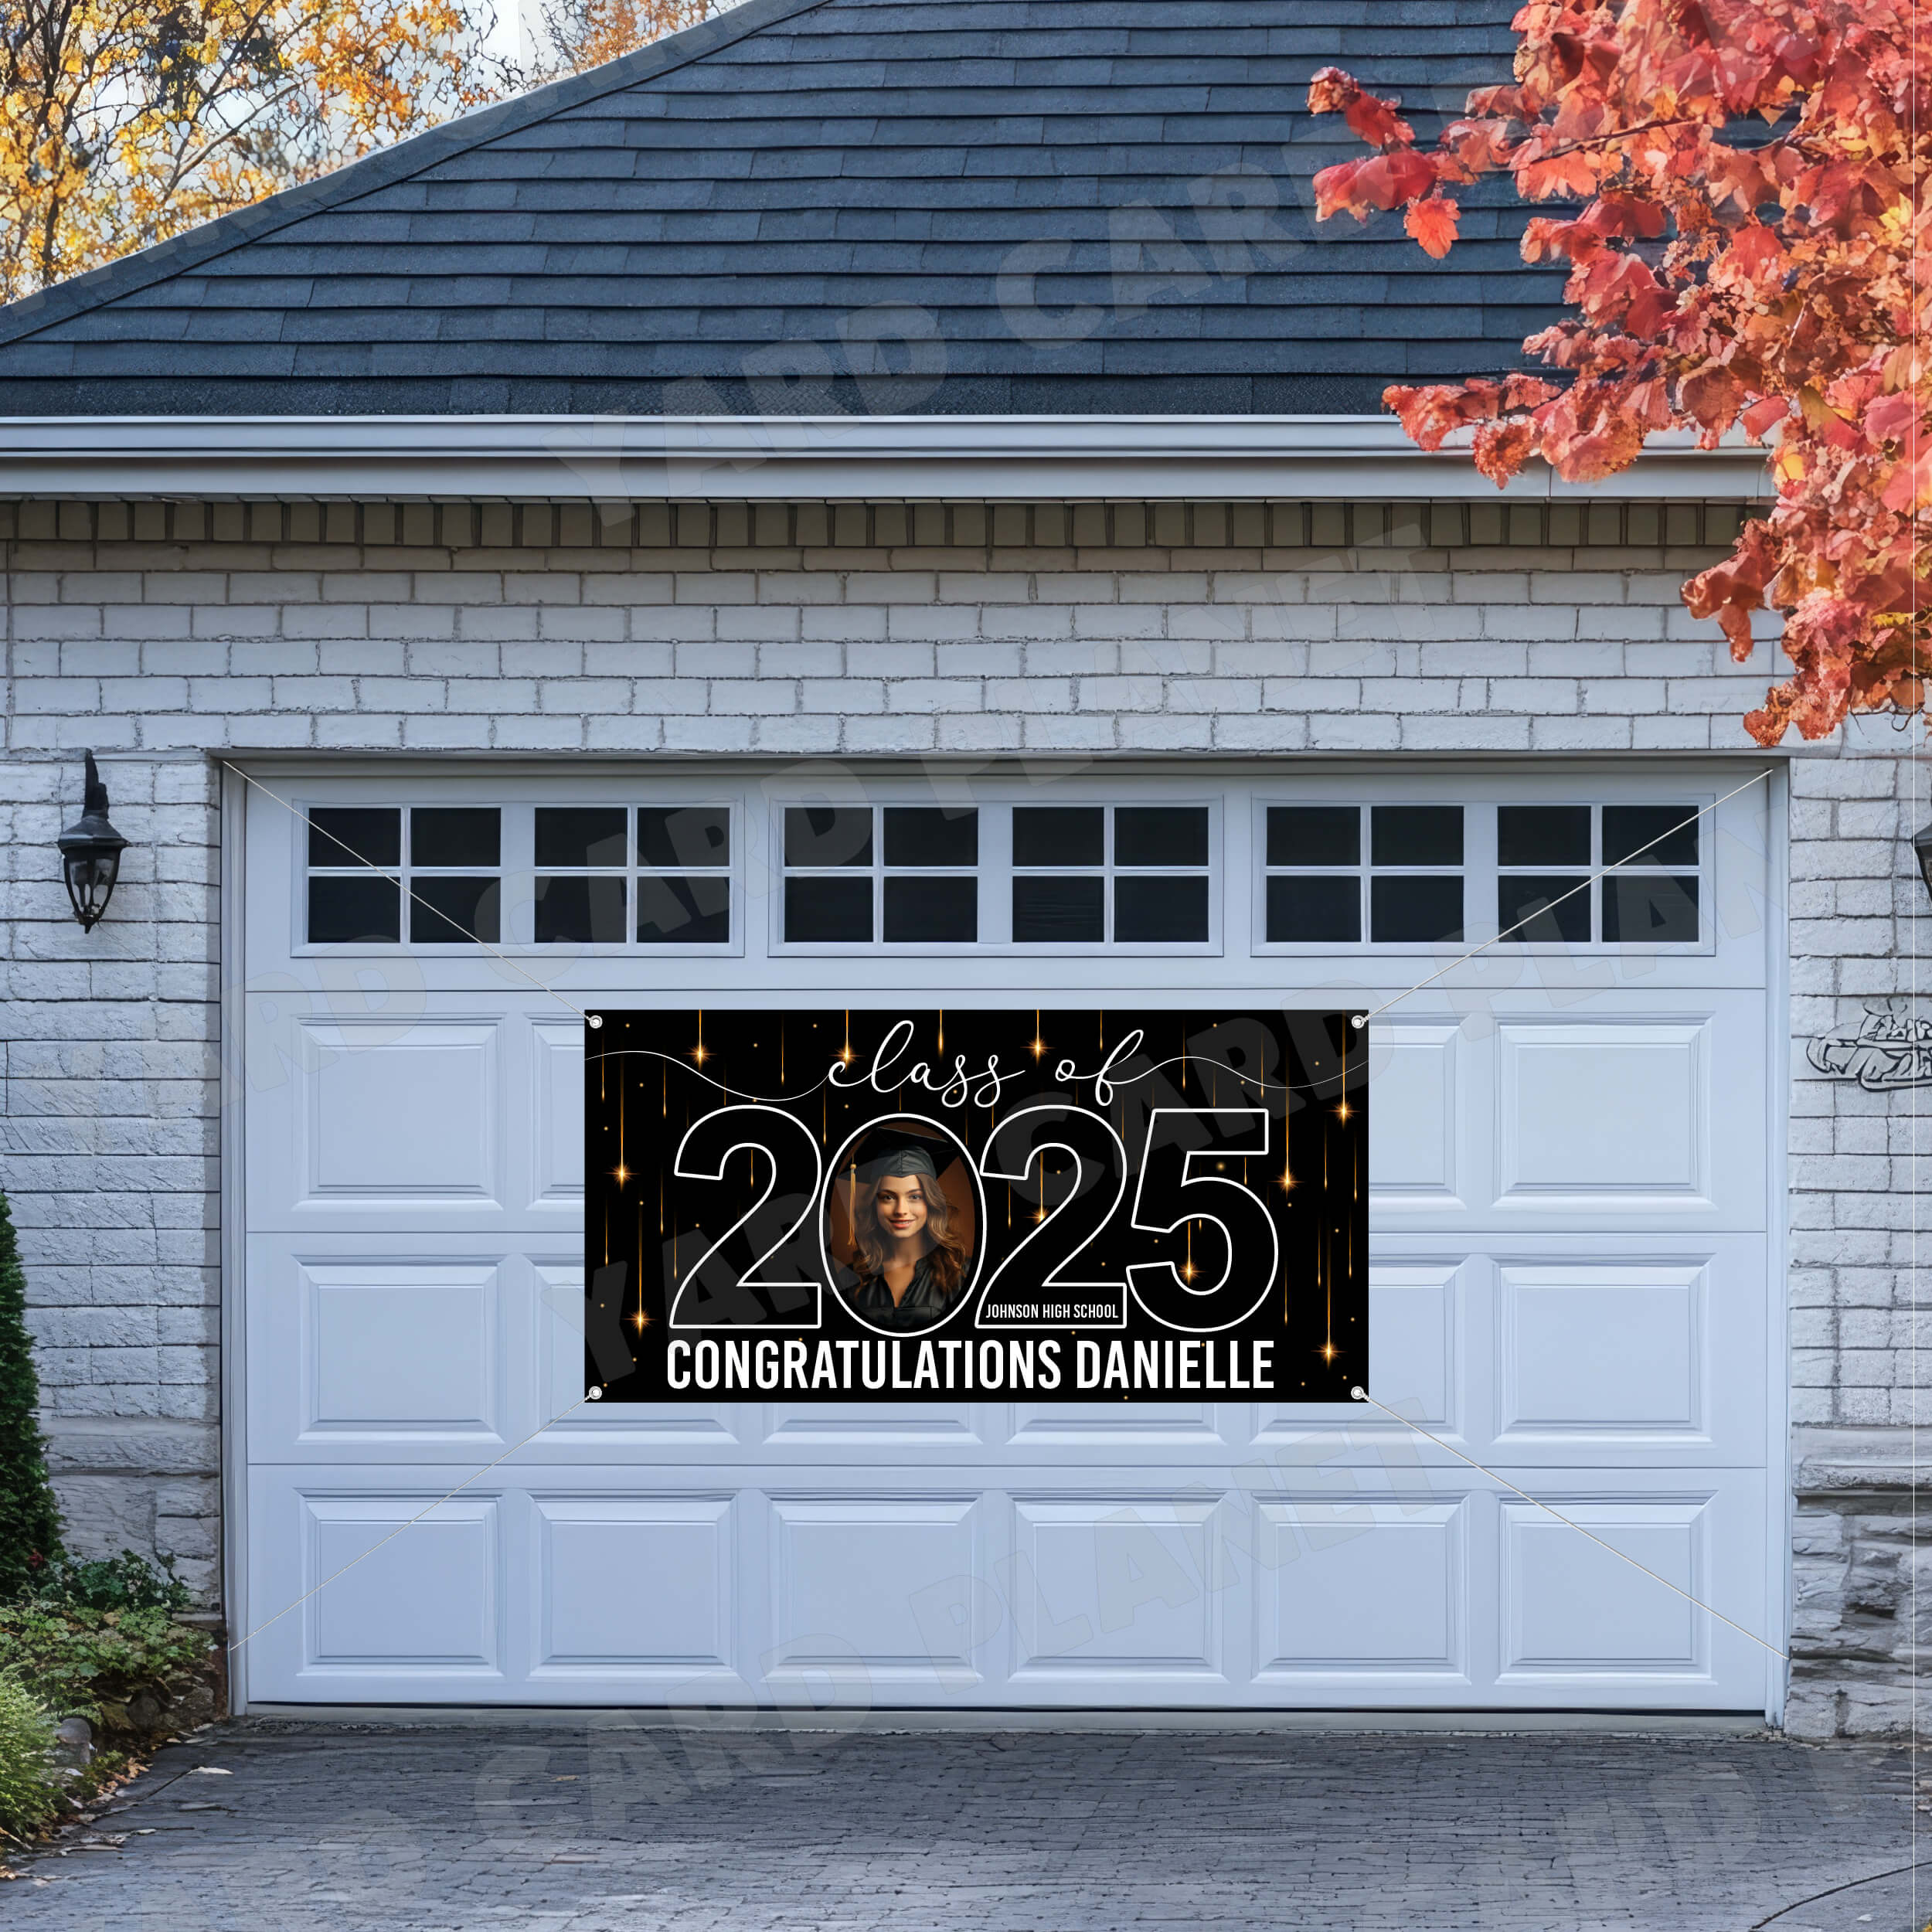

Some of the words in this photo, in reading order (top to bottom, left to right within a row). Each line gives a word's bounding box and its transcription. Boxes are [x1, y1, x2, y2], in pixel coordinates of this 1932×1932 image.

[827, 1019, 1026, 1108] class
[1055, 1028, 1145, 1107] of
[668, 1104, 1279, 1337] 2025
[985, 1304, 1039, 1319] JOHNSON
[1043, 1304, 1071, 1319] HIGH
[1074, 1304, 1119, 1319] SCHOOL
[666, 1339, 1062, 1390] CONGRATULATIONS
[1075, 1339, 1274, 1390] DANIELLE
